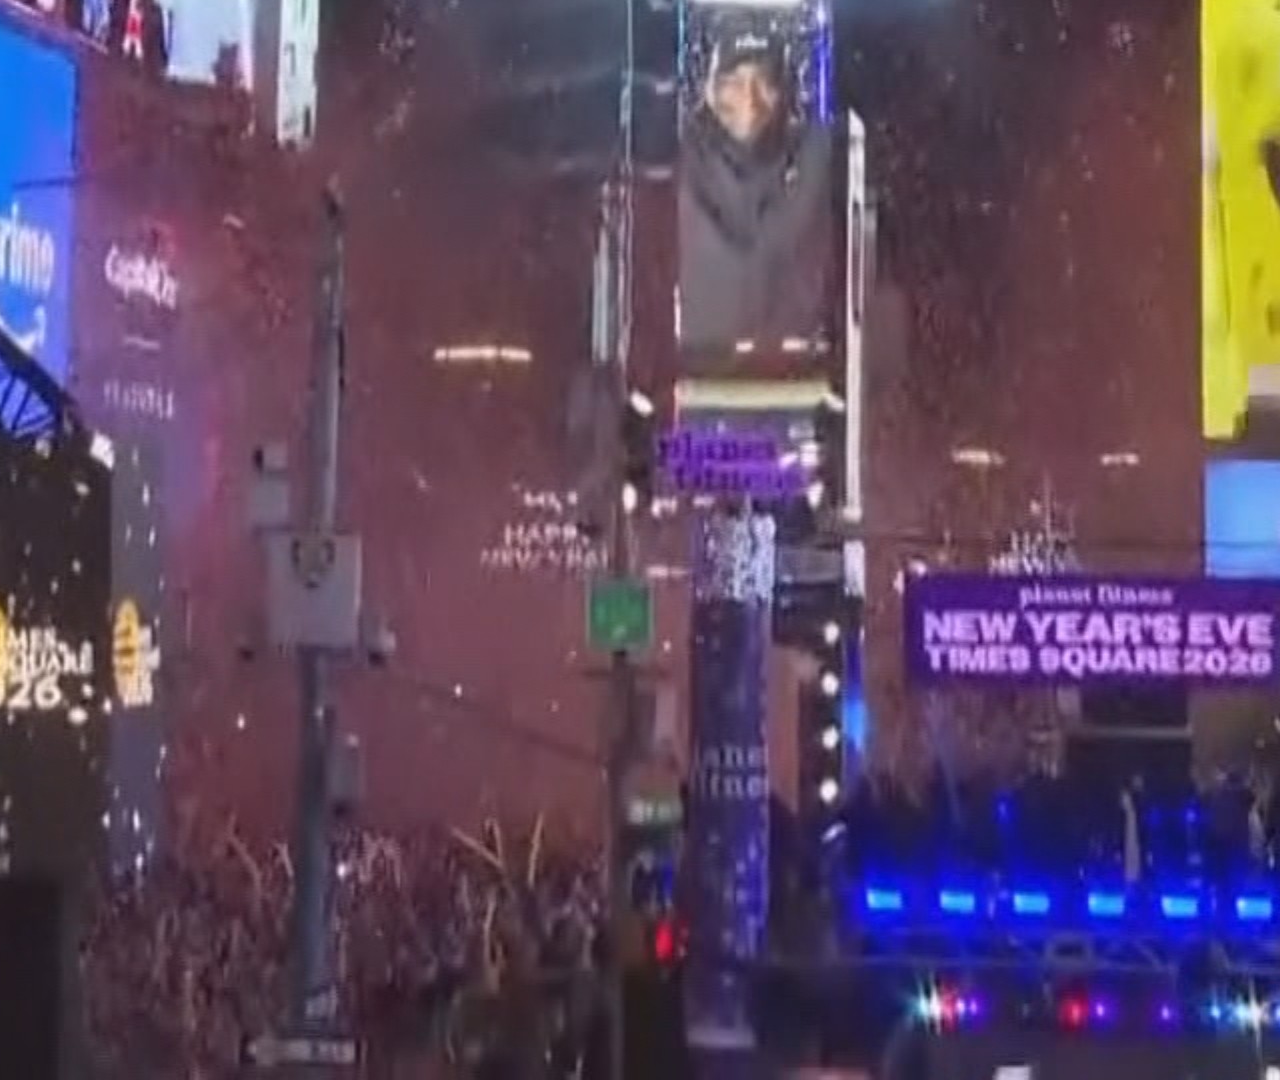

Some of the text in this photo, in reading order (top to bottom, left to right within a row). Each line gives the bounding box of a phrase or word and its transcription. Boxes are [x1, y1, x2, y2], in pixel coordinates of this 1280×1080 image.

[923, 610, 1274, 647] NEW YEAR'S EVE
[924, 644, 1031, 673] TIMES
[1039, 645, 1182, 678] SQUARE
